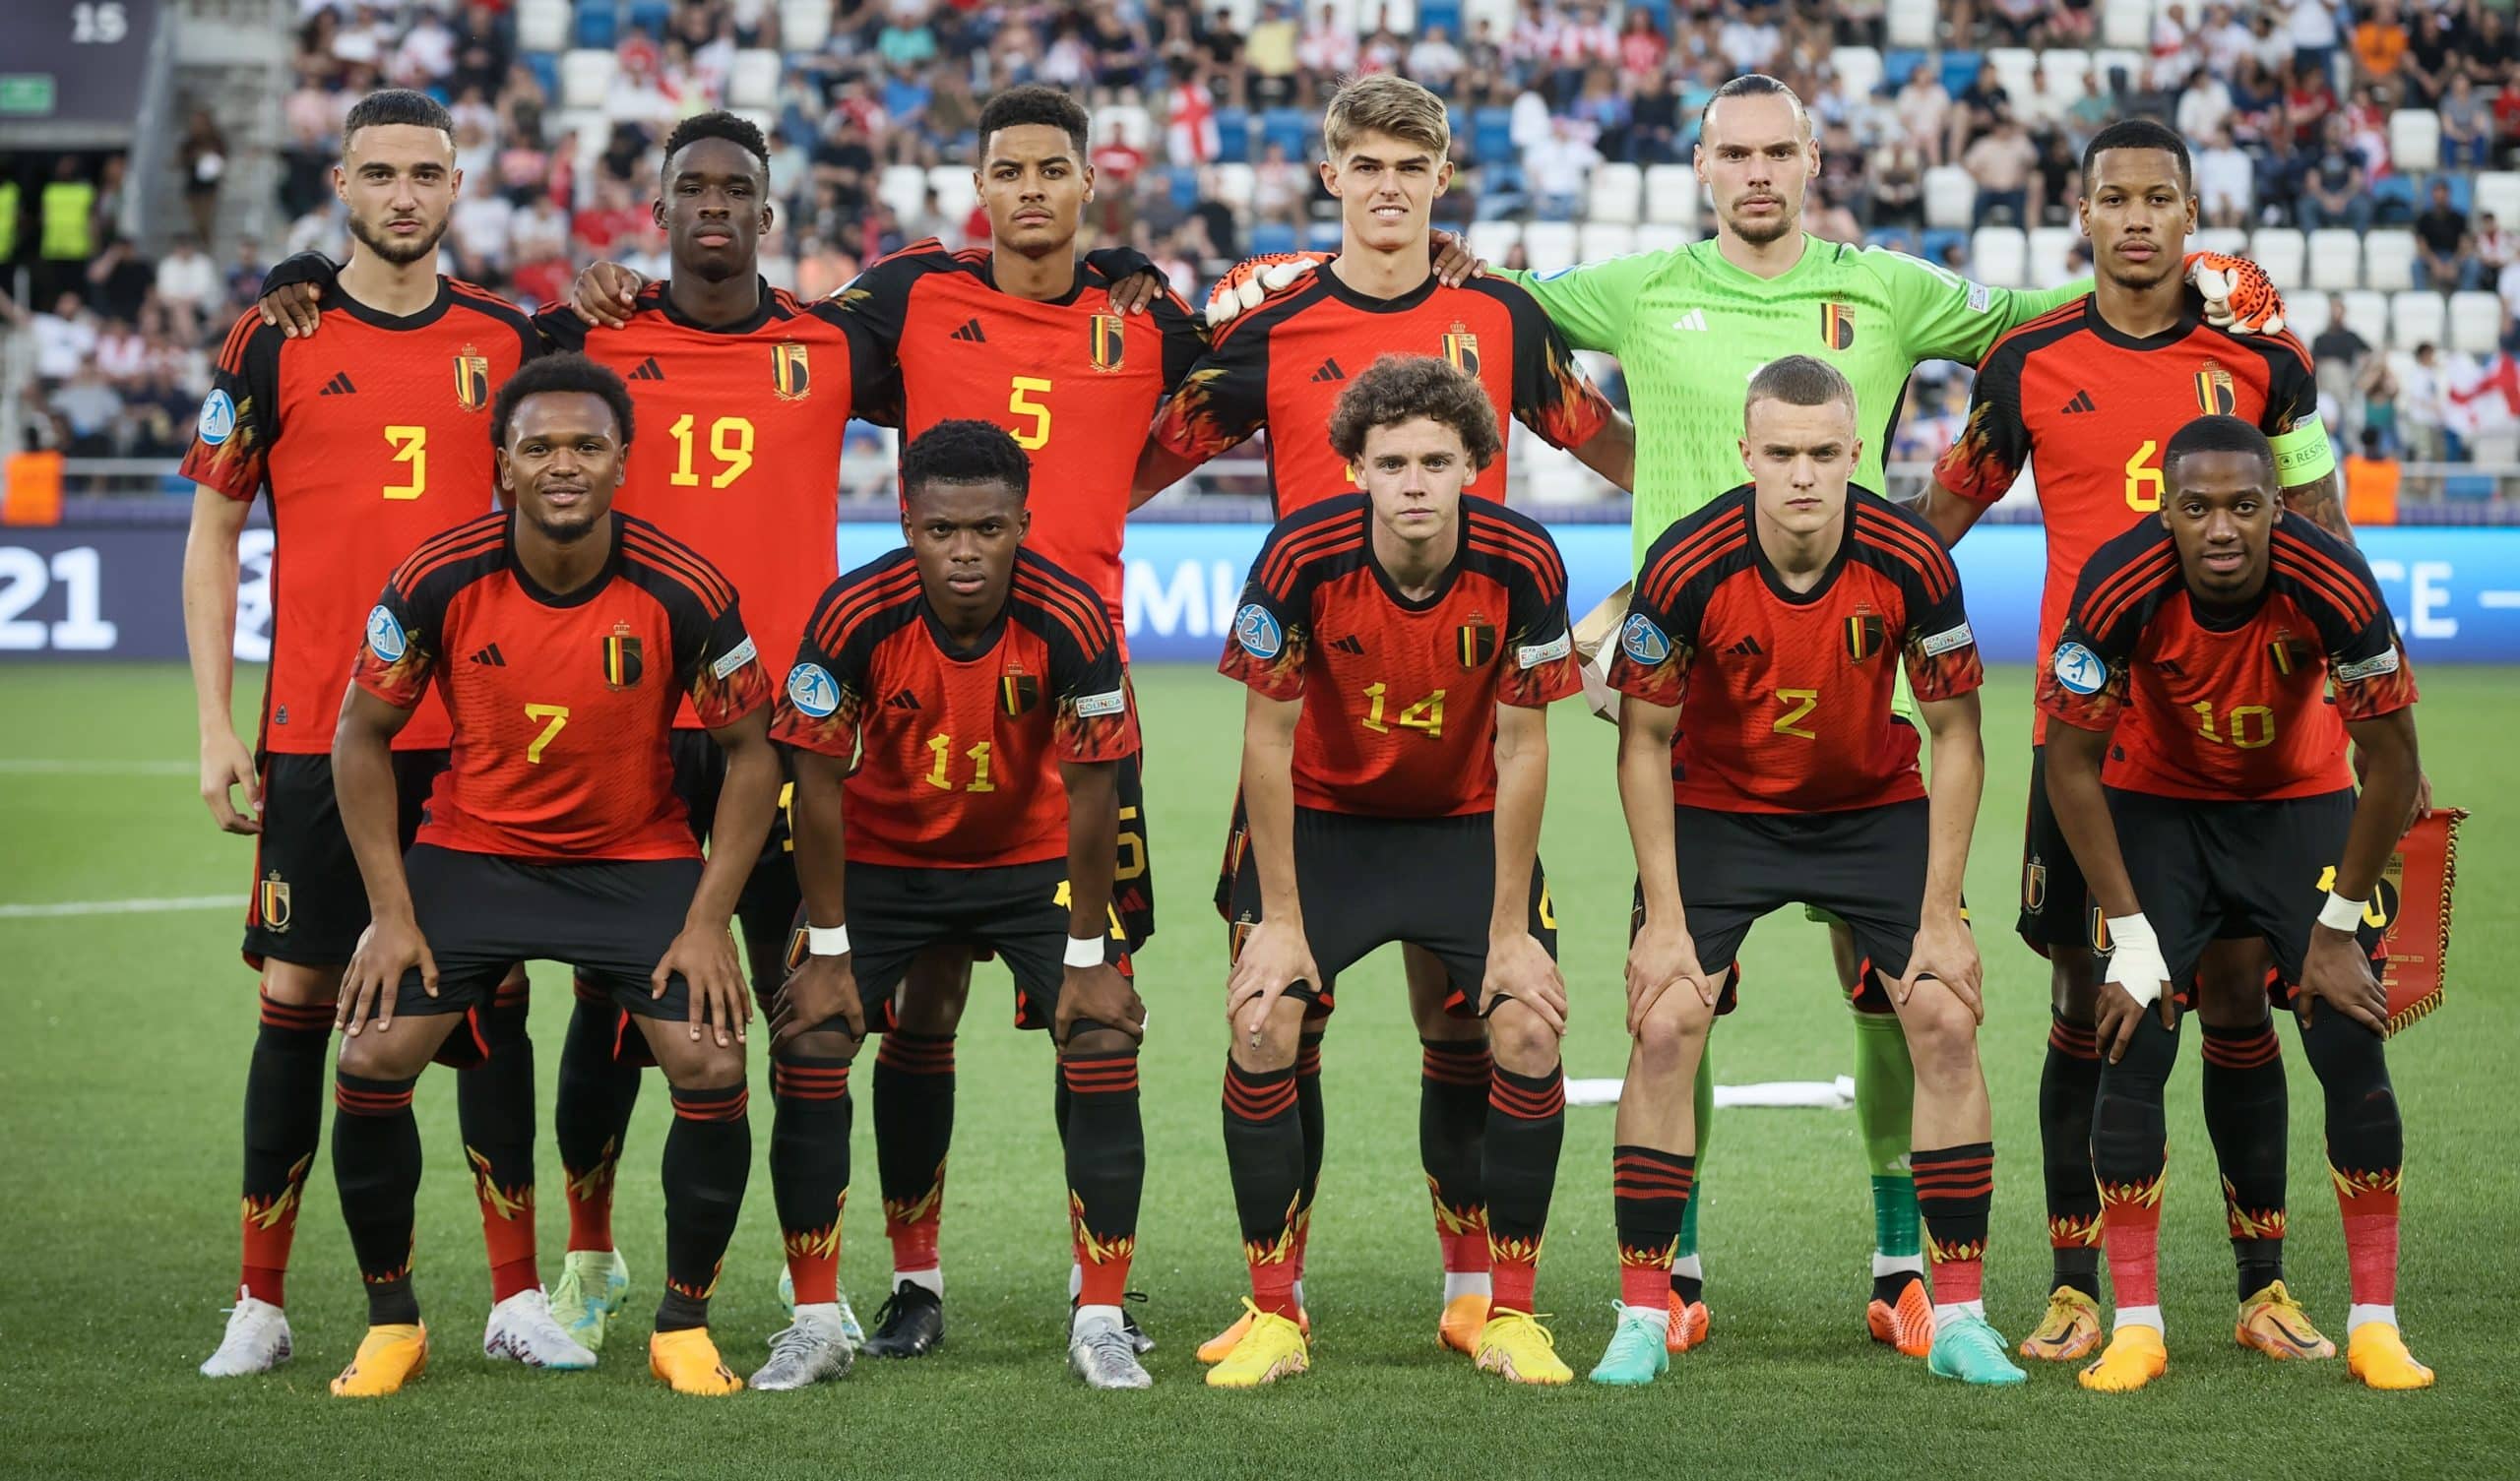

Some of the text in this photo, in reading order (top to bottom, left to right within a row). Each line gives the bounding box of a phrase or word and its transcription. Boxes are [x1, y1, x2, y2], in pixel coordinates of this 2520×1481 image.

[1009, 376, 1052, 450] 5
[383, 425, 426, 499] 3
[668, 414, 754, 488] 19
[2125, 440, 2166, 513] 6
[0, 546, 118, 650] 21
[525, 703, 569, 764] 7
[1362, 681, 1446, 738] 14
[1773, 689, 1817, 740] 2
[2191, 701, 2275, 749] 10
[926, 733, 994, 792] 11
